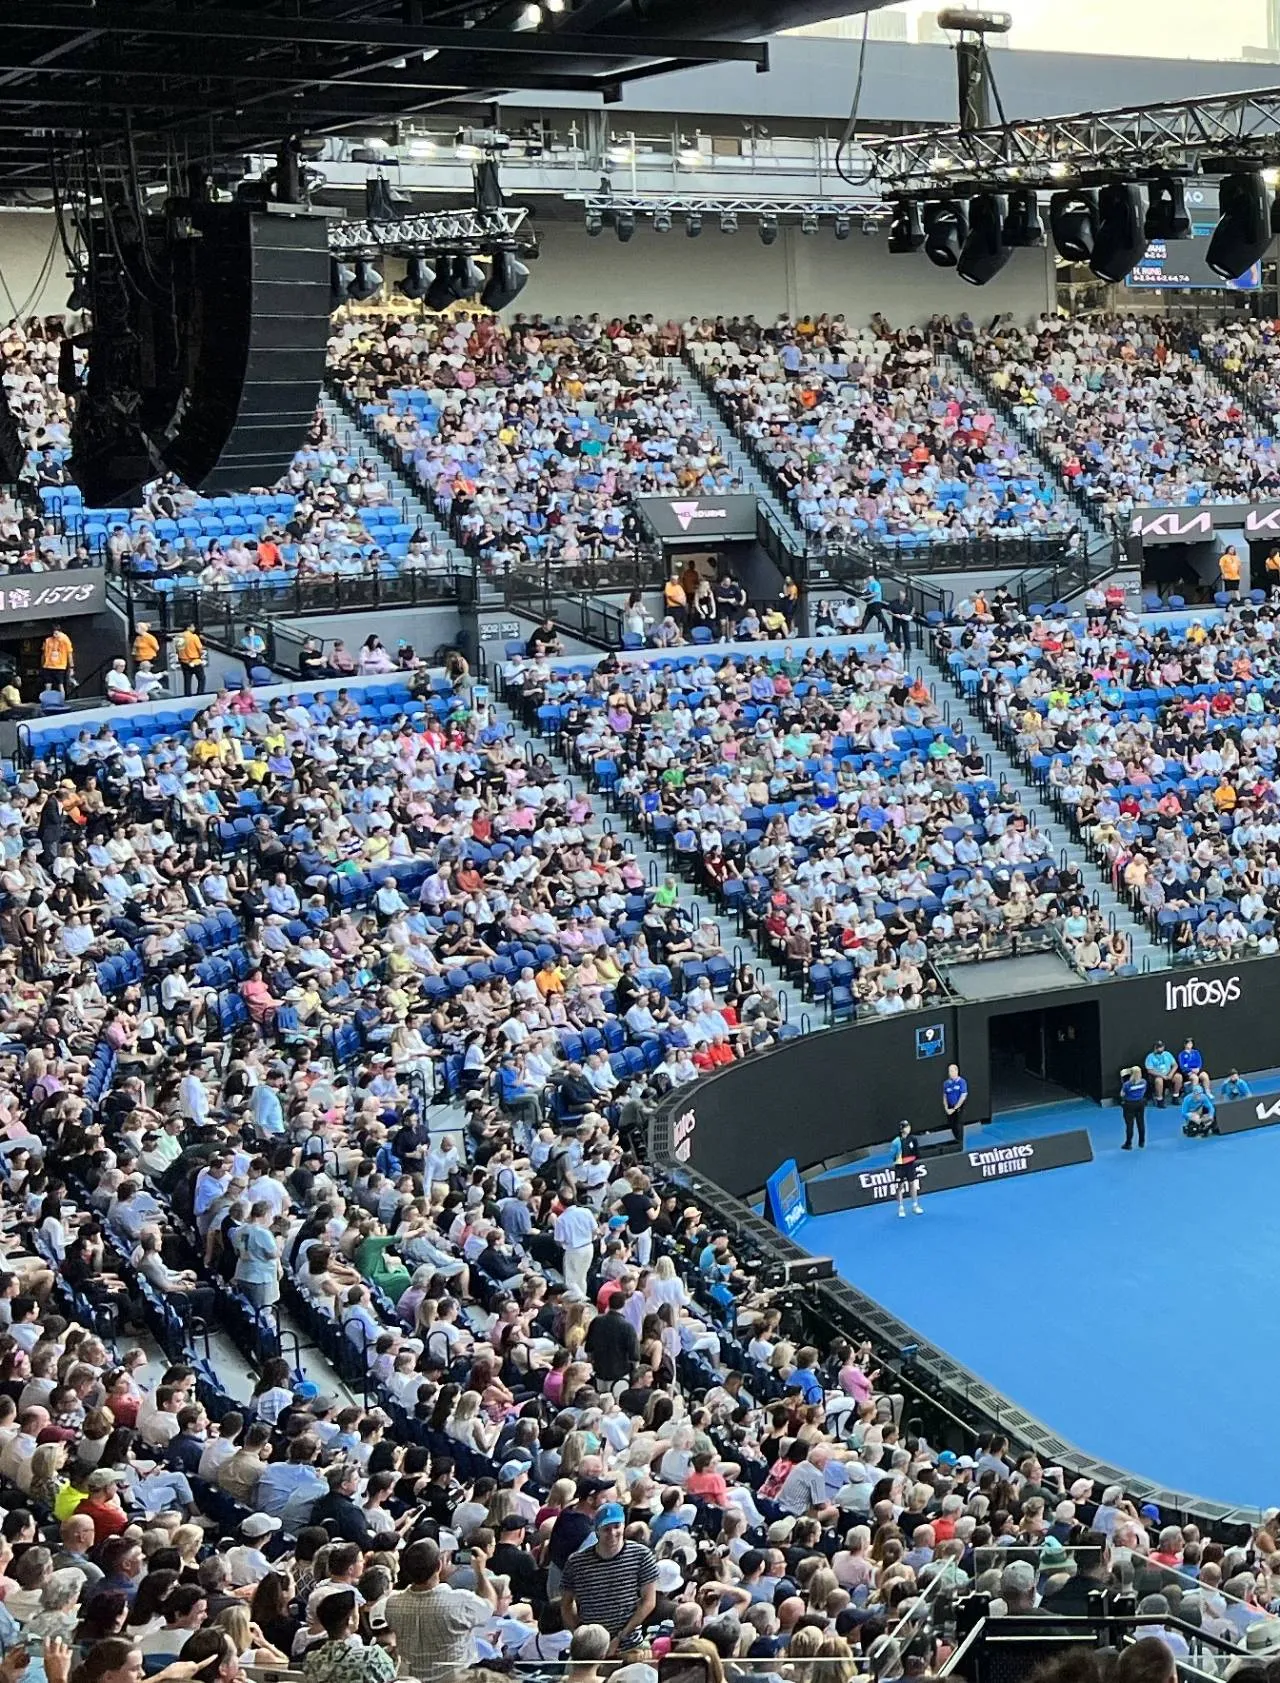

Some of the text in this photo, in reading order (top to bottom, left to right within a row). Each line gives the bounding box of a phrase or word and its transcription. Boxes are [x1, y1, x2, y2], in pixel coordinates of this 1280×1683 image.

[1165, 976, 1241, 1011] Infosys
[968, 1144, 1035, 1167] Emirates
[982, 1158, 1028, 1178] FLY BETTER
[873, 1183, 888, 1199] FLY
